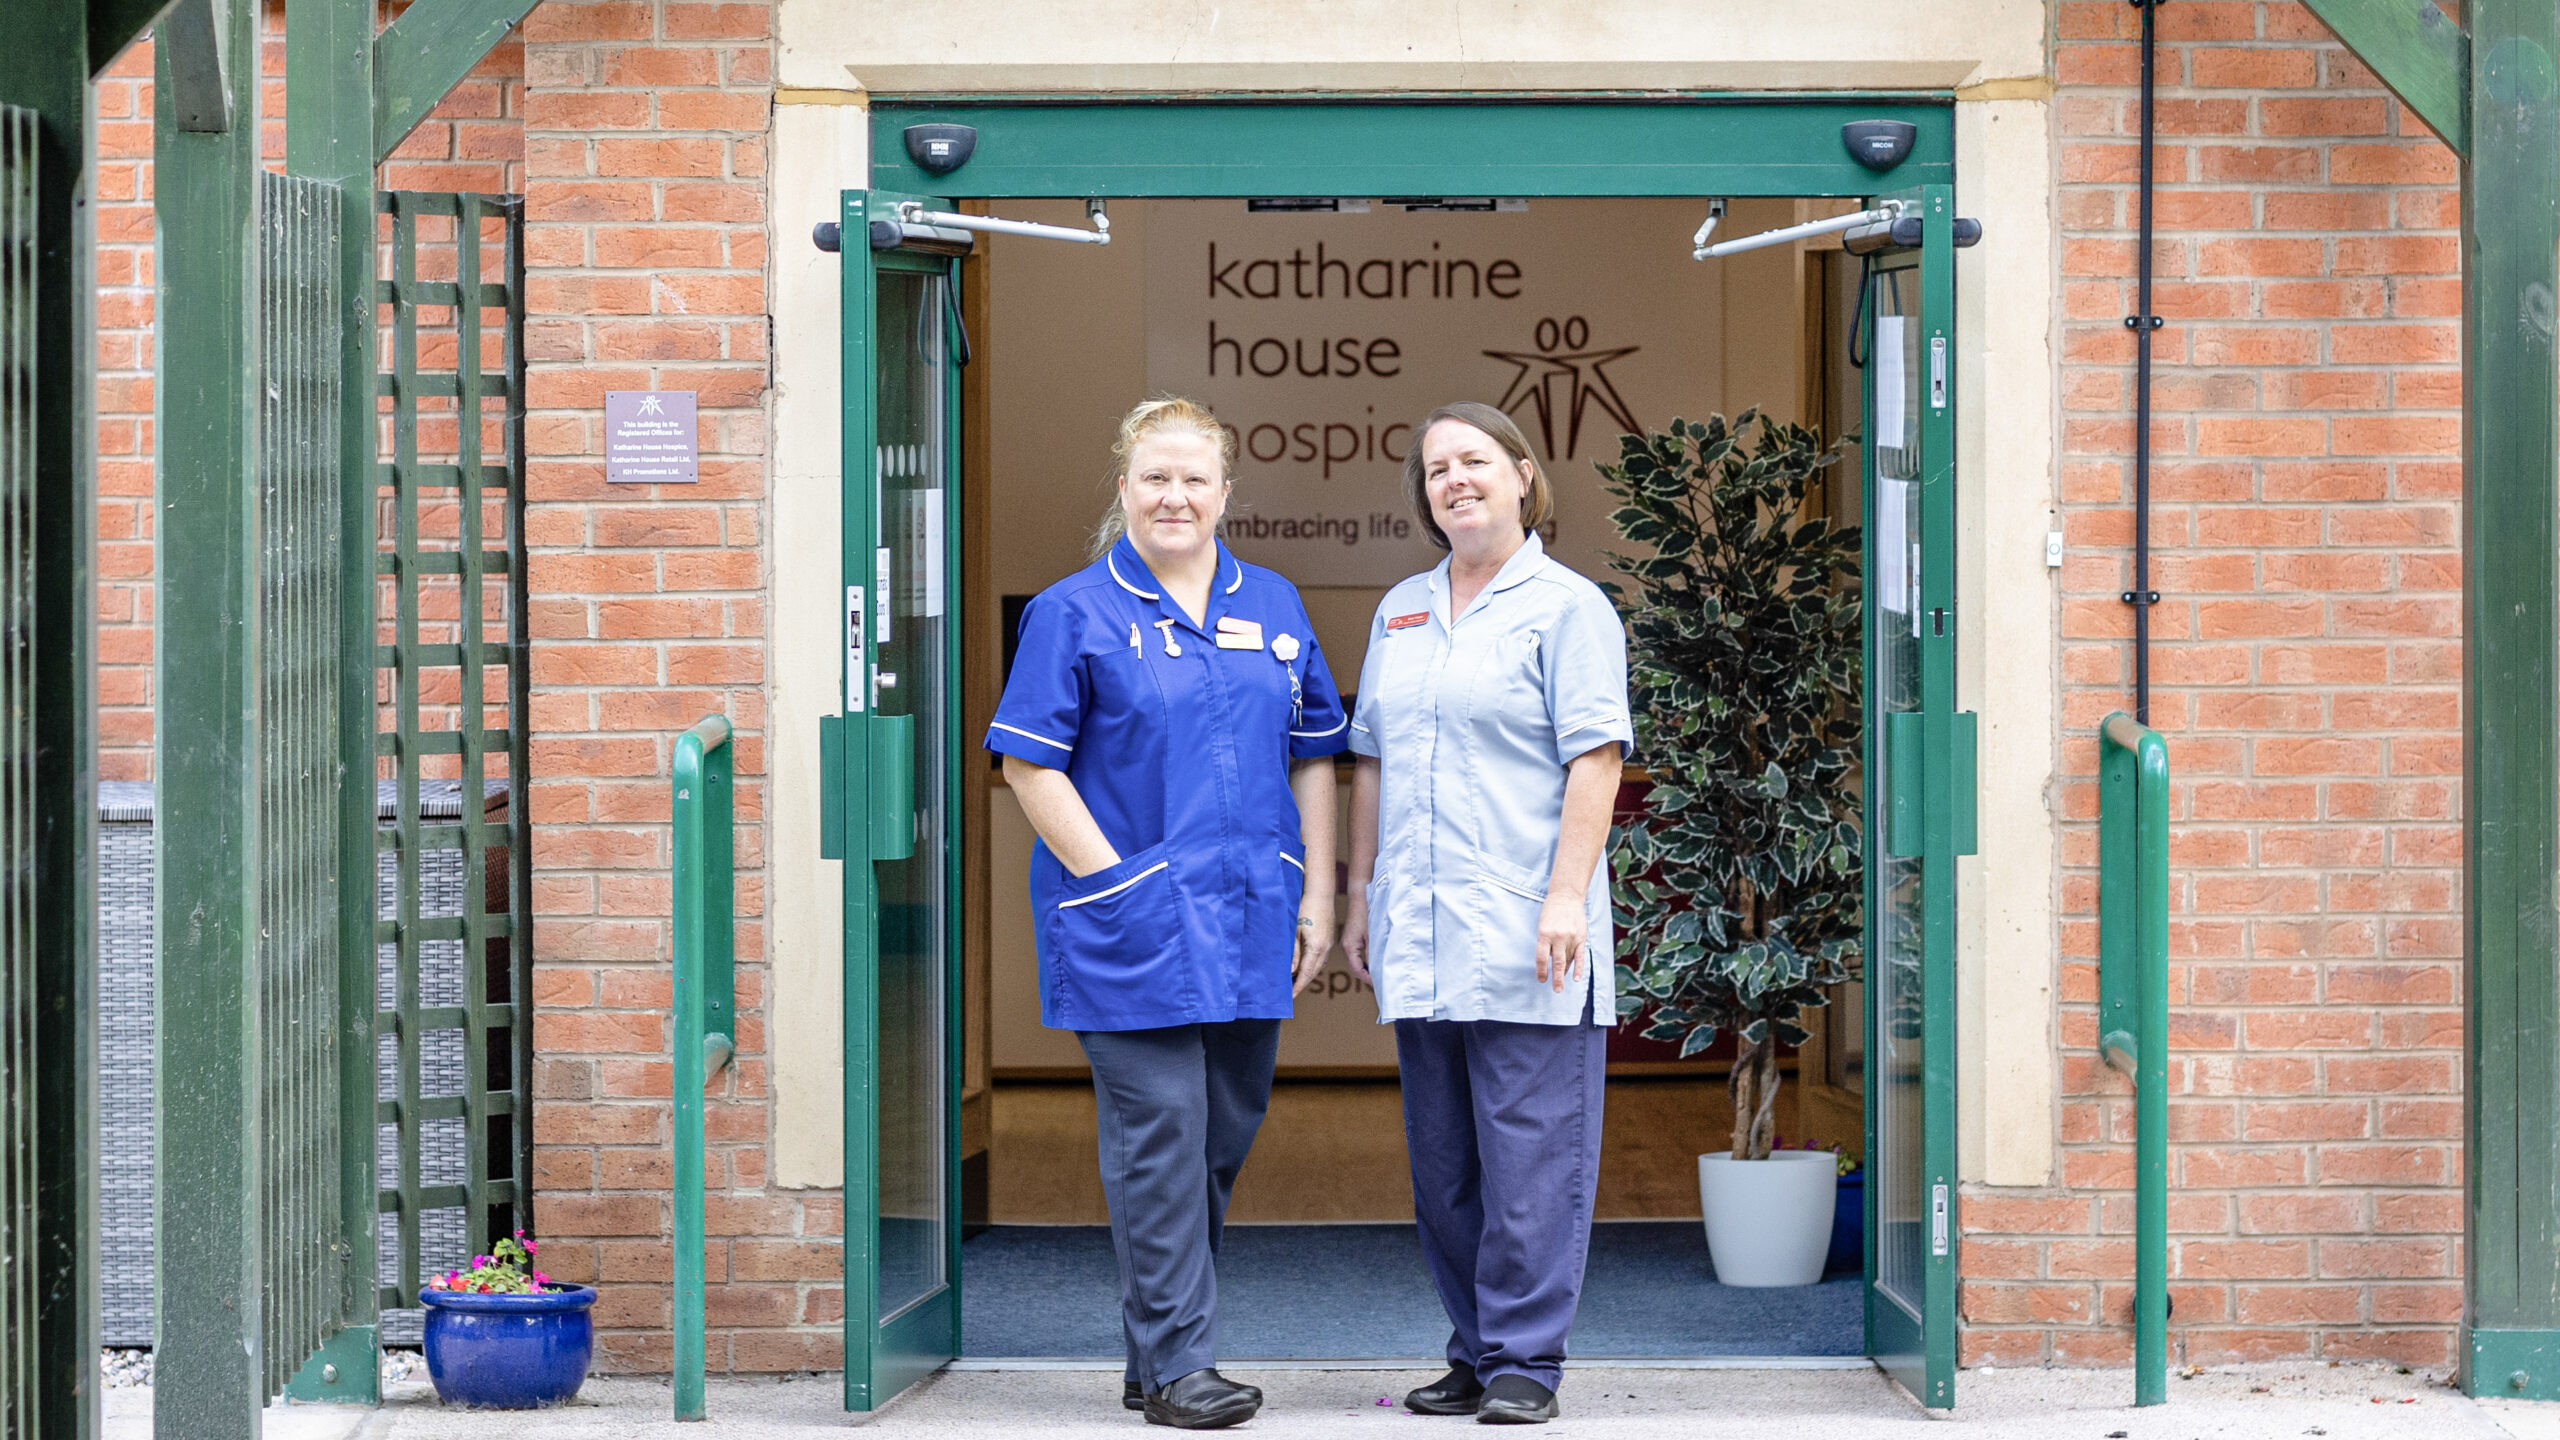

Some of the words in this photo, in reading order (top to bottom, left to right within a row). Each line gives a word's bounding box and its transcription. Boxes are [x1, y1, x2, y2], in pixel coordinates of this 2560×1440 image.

[1208, 241, 1523, 300] katharine
[1208, 320, 1401, 377] house
[617, 429, 650, 437] Registered
[637, 421, 661, 429] building
[1208, 405, 1412, 479] ospic
[1216, 513, 1359, 546] mbracing
[1367, 512, 1410, 540] life
